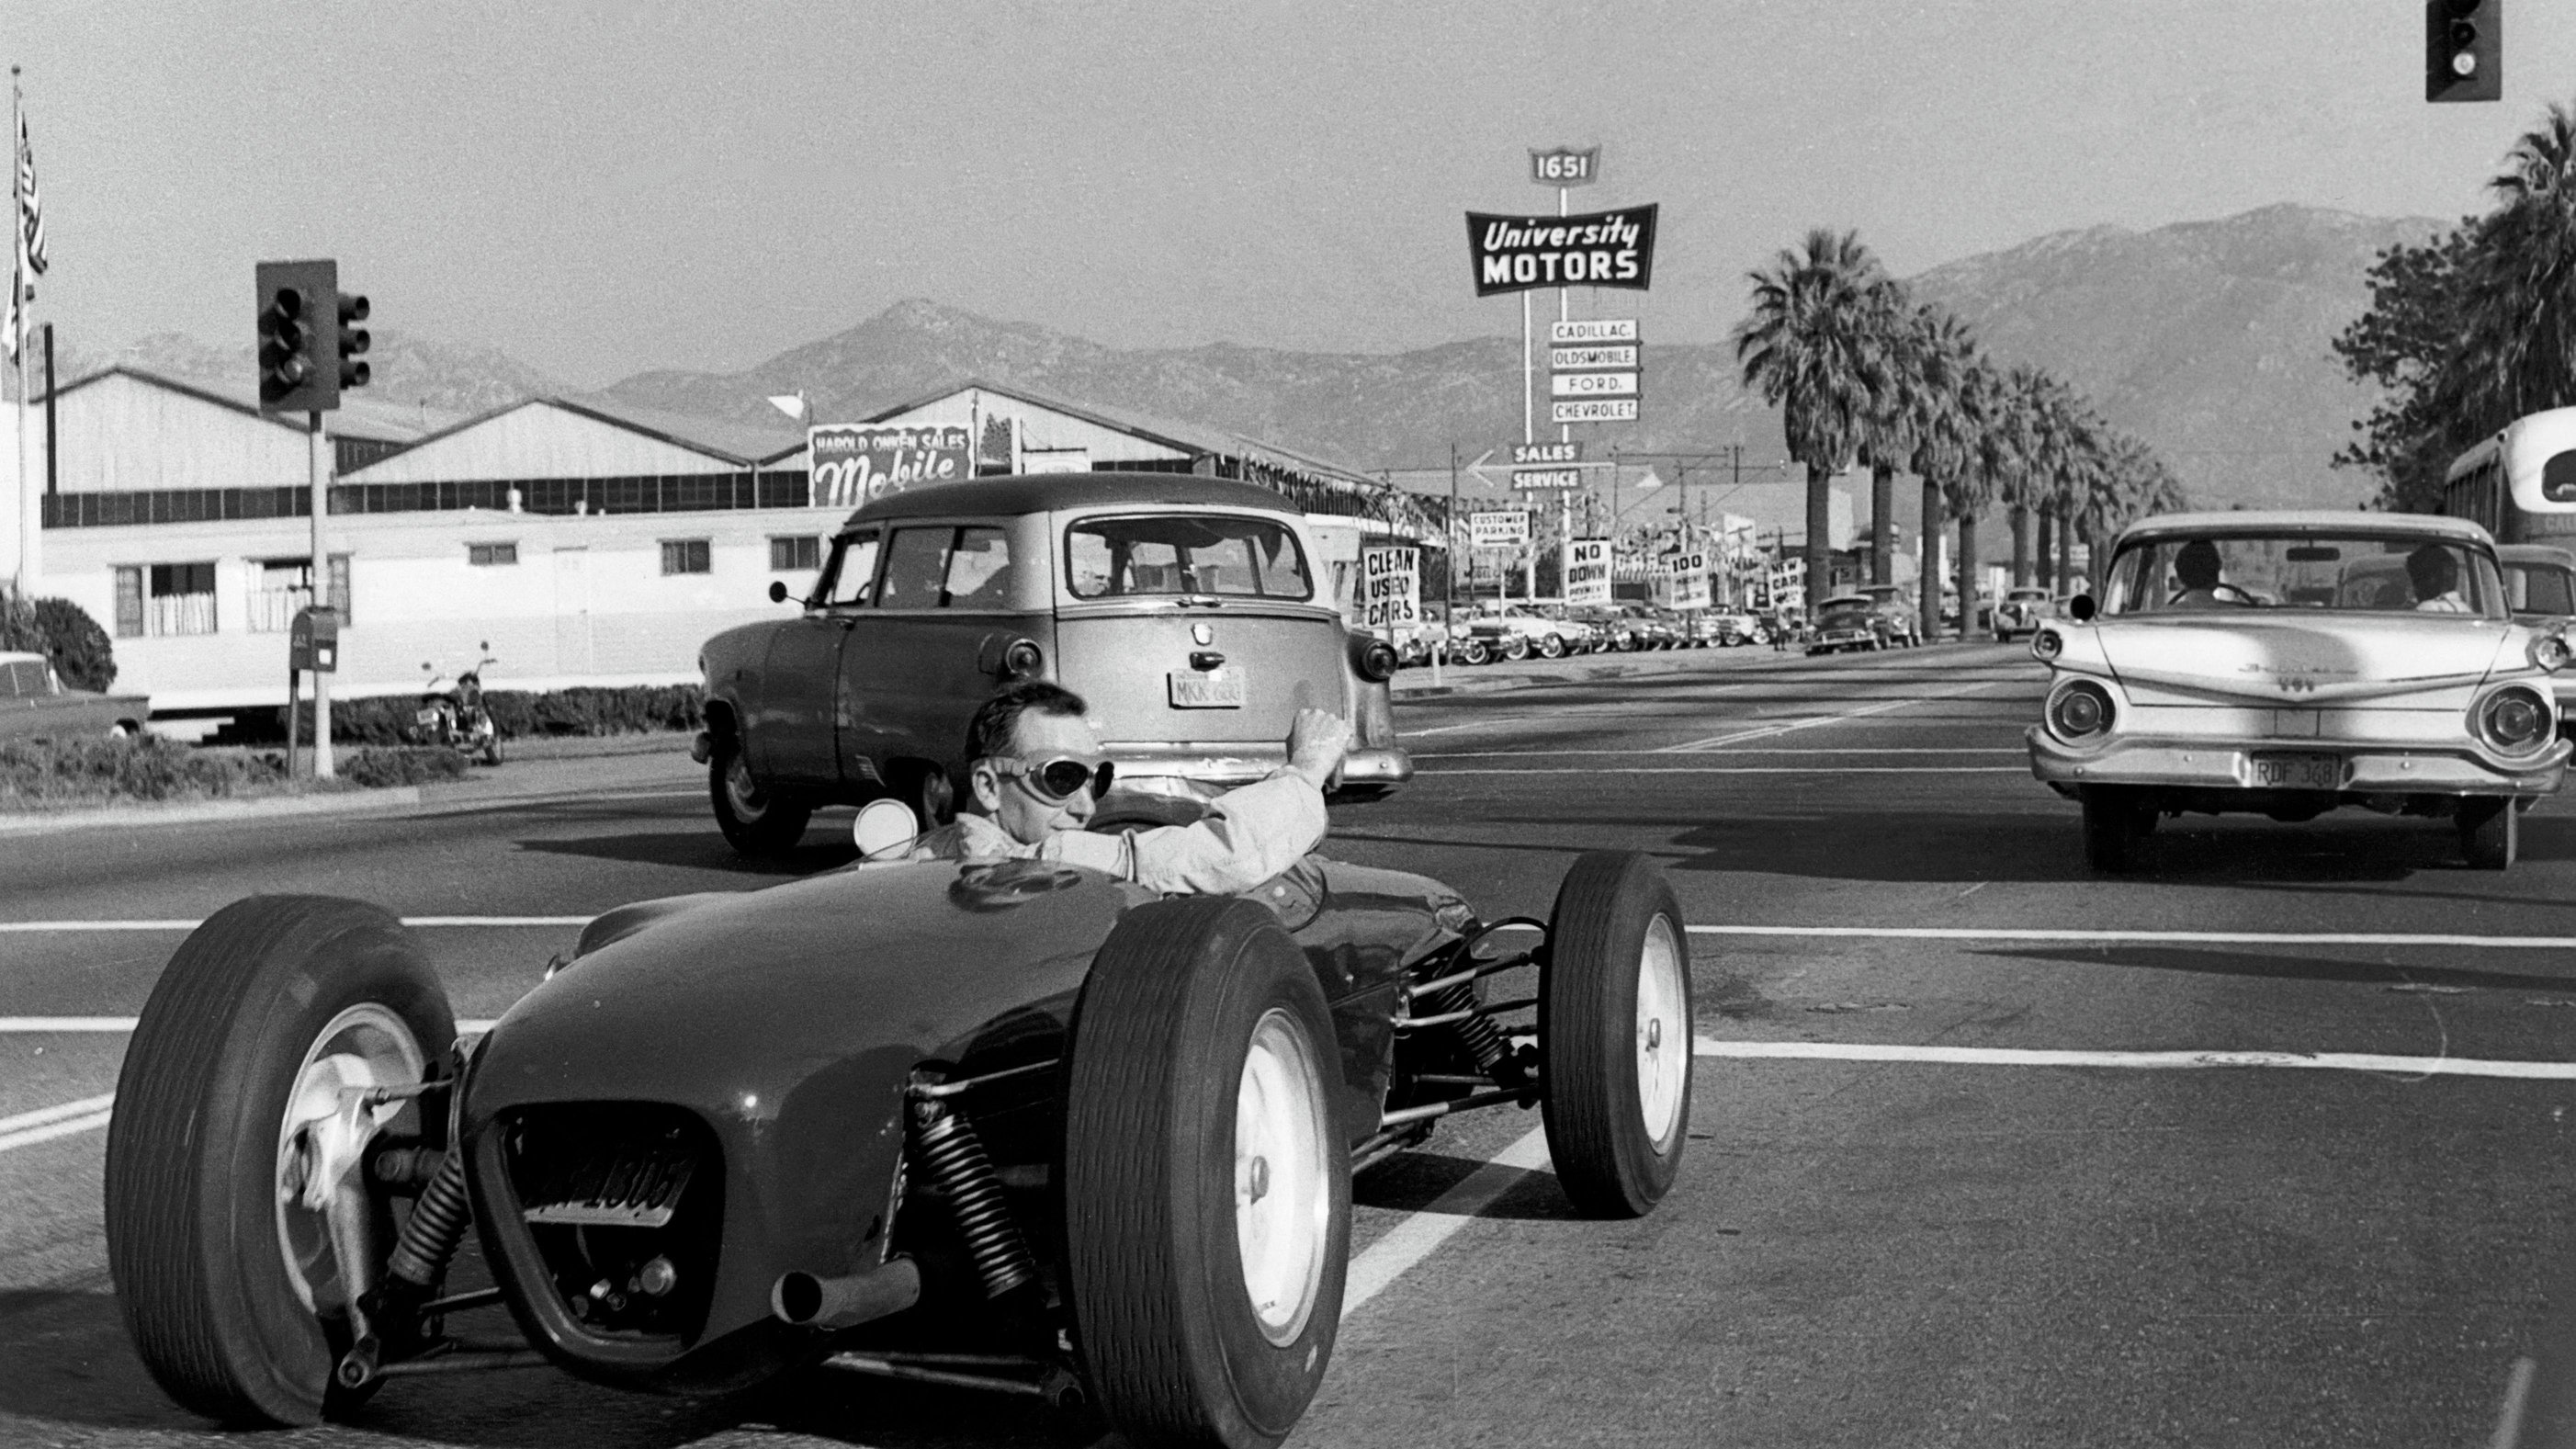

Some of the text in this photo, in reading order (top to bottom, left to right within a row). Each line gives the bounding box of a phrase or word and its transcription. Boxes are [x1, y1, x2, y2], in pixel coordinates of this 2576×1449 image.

[1538, 155, 1587, 179] 1651
[1483, 214, 1641, 252] University
[1483, 249, 1639, 285] MOTORS
[815, 435, 869, 453] HAROLD
[921, 433, 966, 450] SALES
[1515, 444, 1576, 463] SALES
[815, 448, 956, 506] Mobile
[1513, 470, 1579, 490] SERVICE
[1474, 515, 1526, 524] CUSTOMER
[1475, 526, 1525, 536] PARKING
[1368, 549, 1415, 577] CLEAN
[1574, 543, 1601, 563] NO
[1672, 553, 1703, 573] 100
[1568, 563, 1607, 584] DOWN
[1770, 560, 1798, 573] NEW
[1371, 575, 1410, 599] USED
[1772, 574, 1799, 590] CAR
[1368, 599, 1414, 626] CARS
[2257, 761, 2295, 783] RDF
